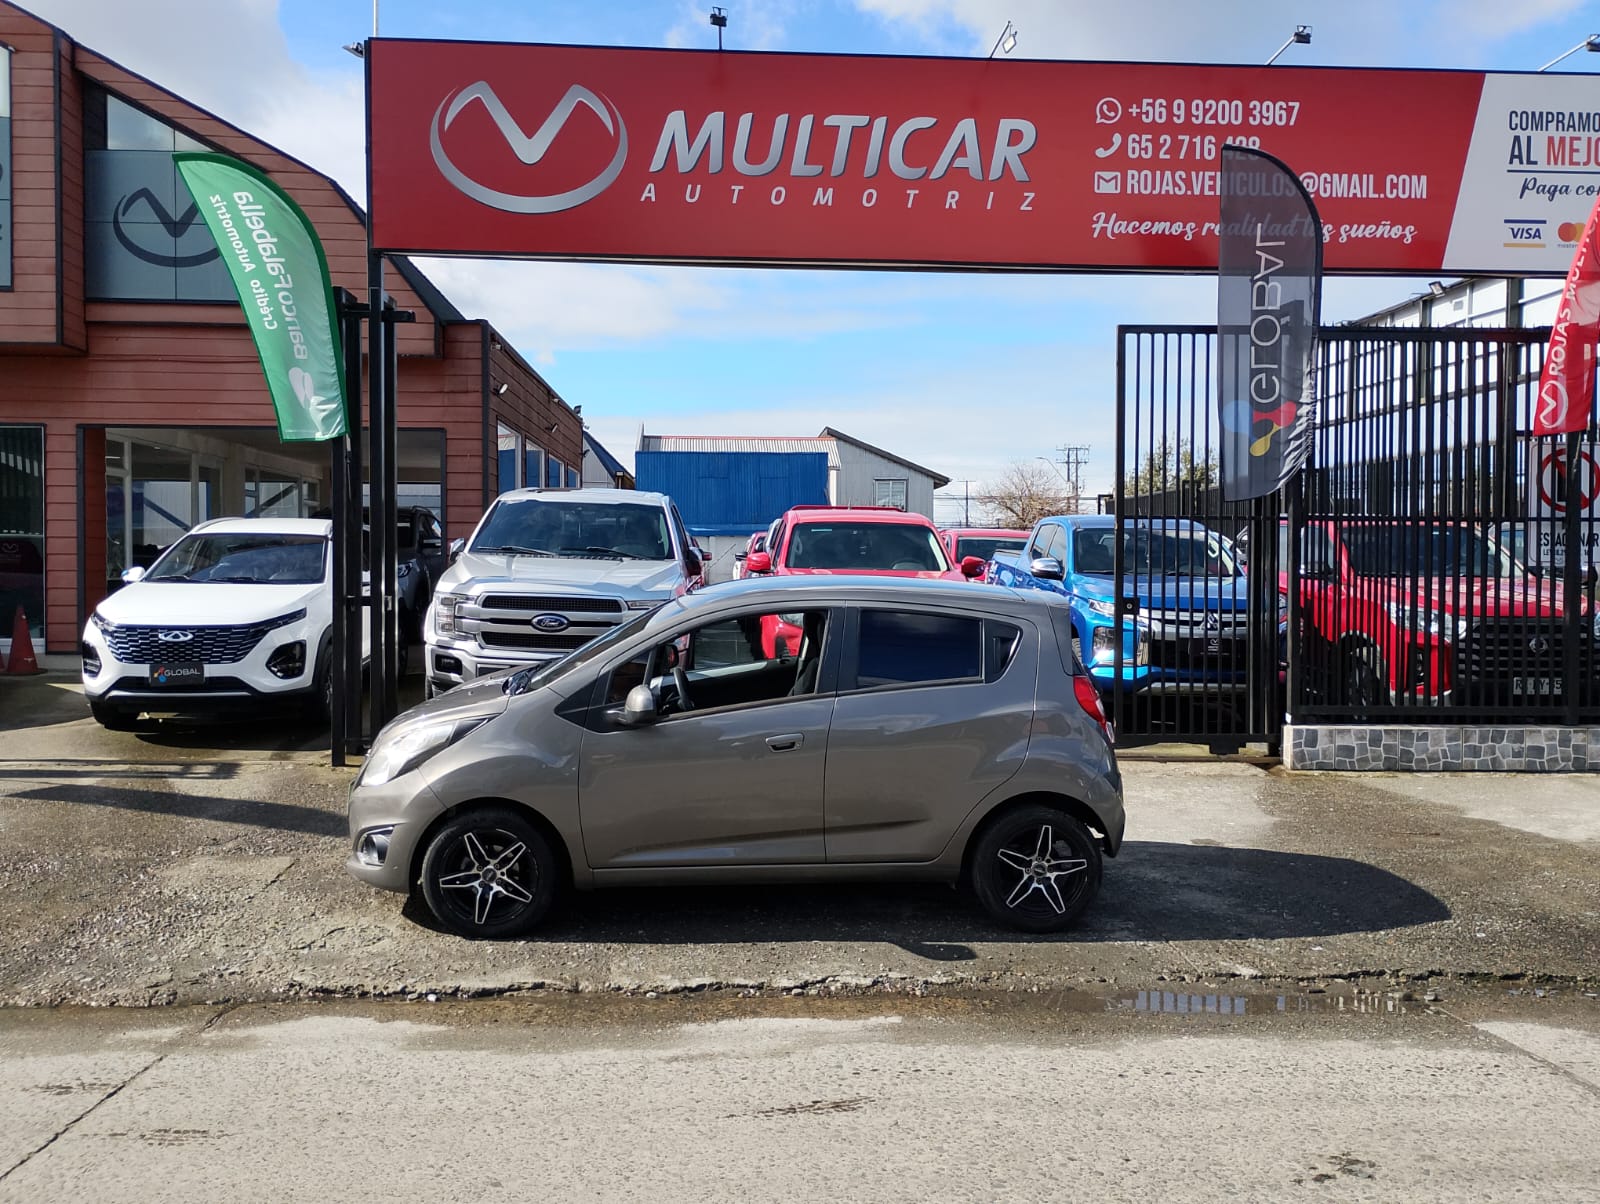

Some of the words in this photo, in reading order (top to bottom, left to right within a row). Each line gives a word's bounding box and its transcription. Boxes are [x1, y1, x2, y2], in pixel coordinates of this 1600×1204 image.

[1128, 98, 1167, 124] +56
[1172, 98, 1186, 125] 9
[1191, 99, 1243, 126] 9200
[1248, 100, 1300, 127] 3967
[648, 110, 1037, 183] MULTICAR
[1127, 133, 1153, 159] 65
[1159, 134, 1172, 160] 2
[1178, 135, 1216, 160] 716
[1508, 135, 1539, 166] AL
[640, 182, 1036, 212] AUTOMOTRIZ
[1519, 177, 1572, 202] Paga
[1092, 211, 1199, 241] Hacemos
[1339, 220, 1418, 244] sueños
[1509, 226, 1542, 240] VISA
[1549, 307, 1571, 377] ROJAS
[164, 667, 201, 677] GLOBAL
